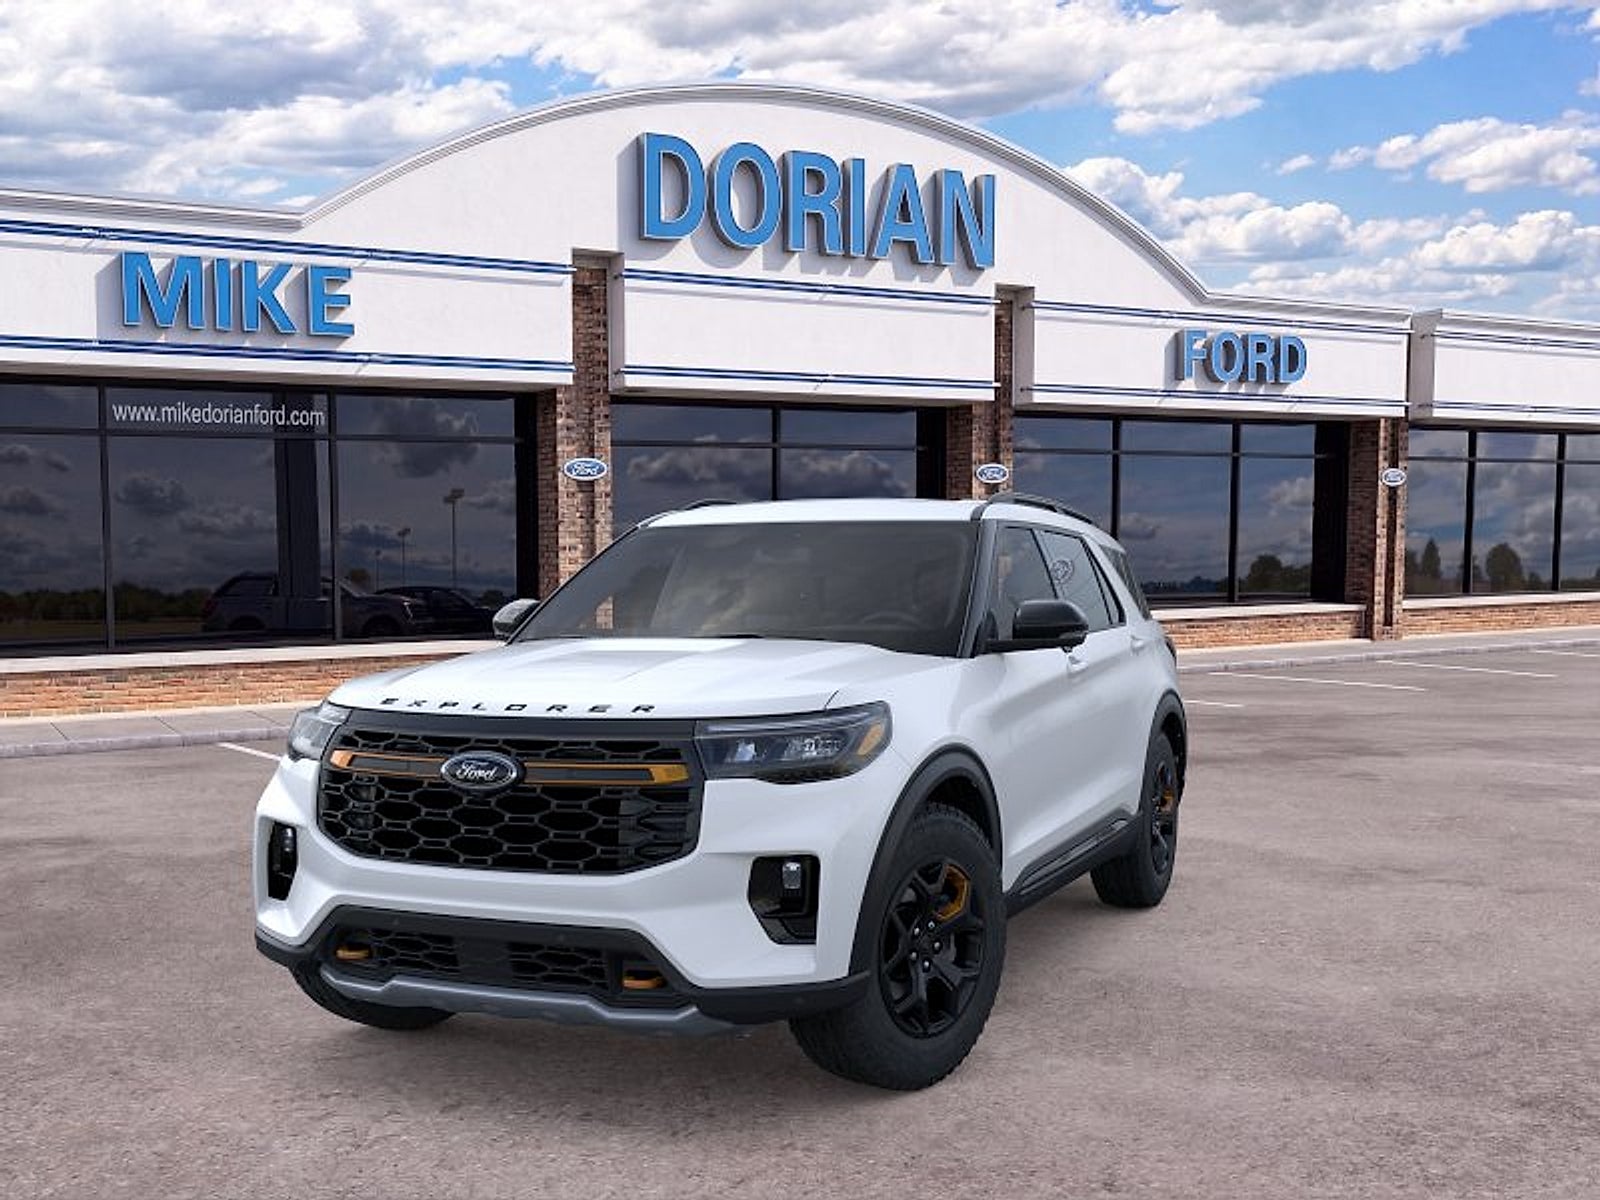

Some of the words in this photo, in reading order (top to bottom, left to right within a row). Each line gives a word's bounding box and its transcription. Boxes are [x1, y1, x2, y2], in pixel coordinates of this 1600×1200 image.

[639, 131, 996, 270] DORIAN
[121, 251, 355, 338] MIKE
[1178, 327, 1308, 384] FORD
[112, 402, 326, 426] www.mikedorianford.com
[379, 697, 656, 714] EXPLORER
[456, 760, 498, 781] Ford
